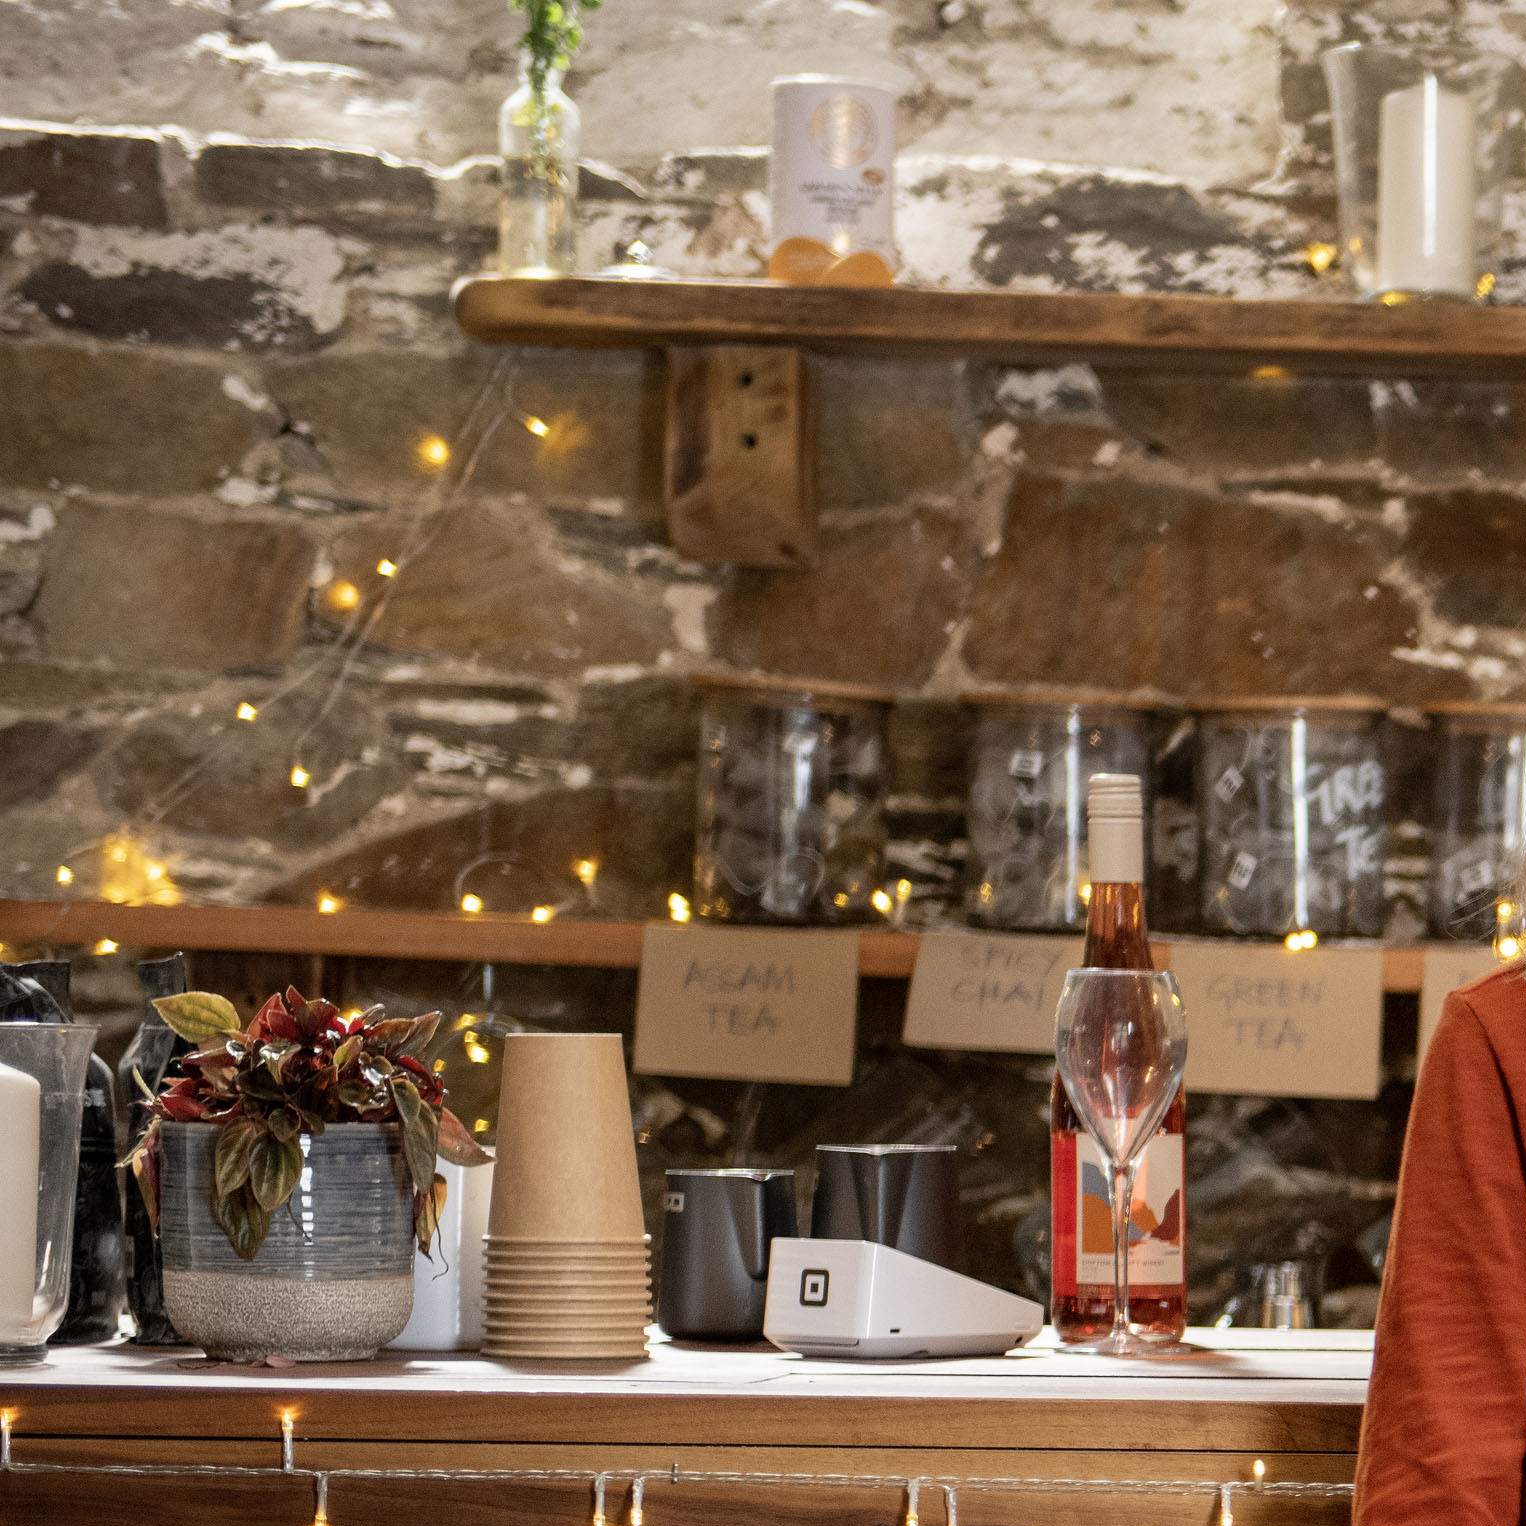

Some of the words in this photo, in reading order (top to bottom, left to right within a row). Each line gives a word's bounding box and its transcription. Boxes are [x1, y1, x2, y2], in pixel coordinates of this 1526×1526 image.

[683, 957, 796, 996] ASSAM
[959, 943, 1067, 978] SPICY
[950, 979, 1045, 1014] CHAI
[1205, 973, 1328, 1014] GREEN
[700, 1000, 784, 1037] TEA
[1222, 1016, 1308, 1051] TEA
